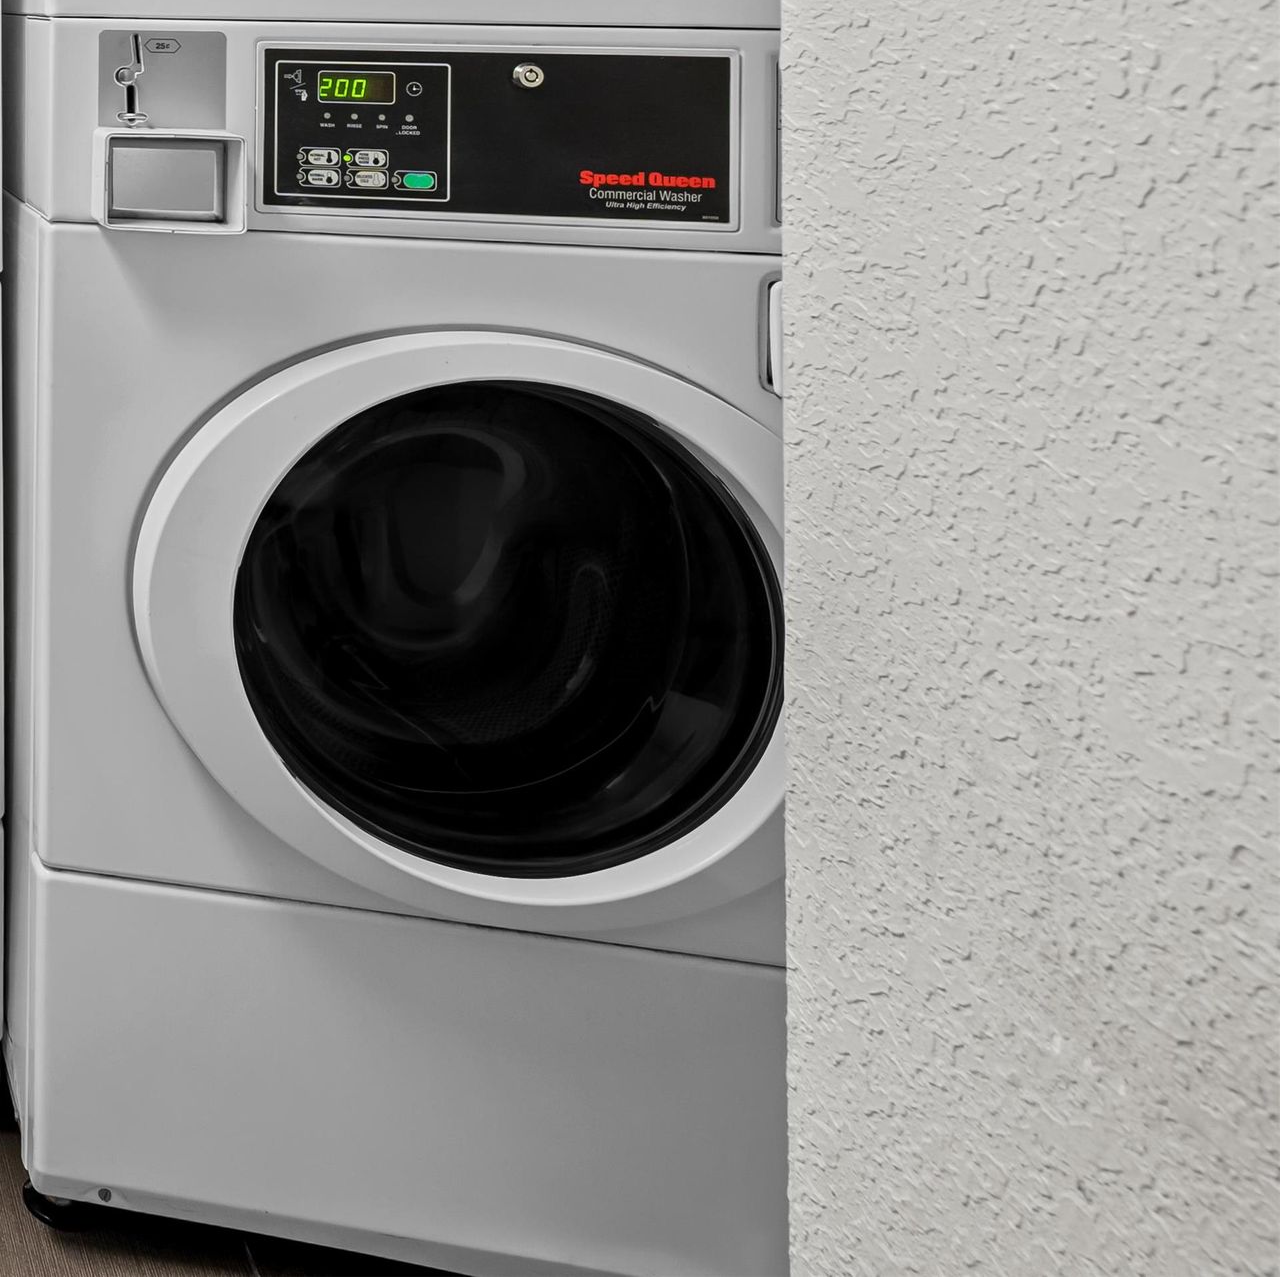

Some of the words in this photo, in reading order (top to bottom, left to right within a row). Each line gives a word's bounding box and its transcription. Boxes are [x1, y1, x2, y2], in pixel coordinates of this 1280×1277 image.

[319, 78, 367, 98] 200
[579, 170, 645, 188] Speed
[648, 172, 716, 189] Queen
[589, 187, 656, 201] Commercial
[659, 190, 703, 203] Washer
[605, 201, 625, 209] Ultra
[626, 202, 645, 210] High
[646, 202, 687, 212] Efficiency
